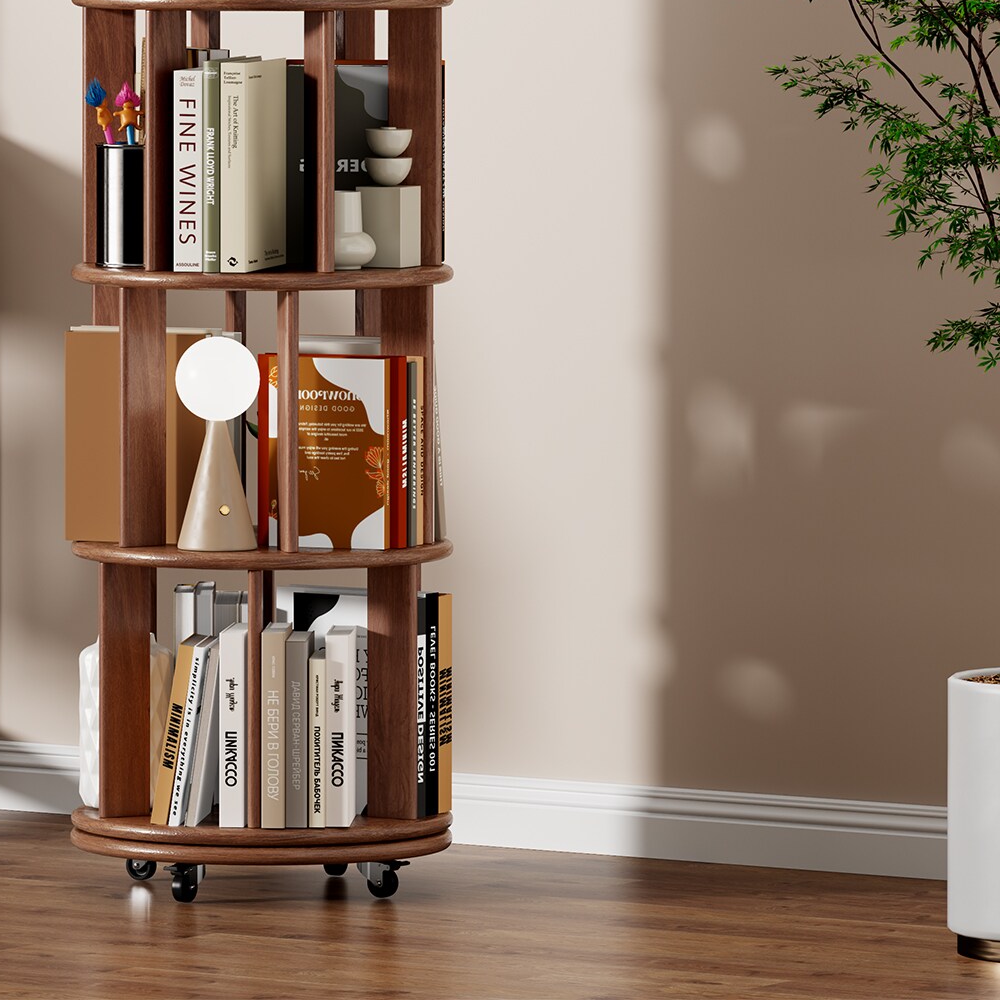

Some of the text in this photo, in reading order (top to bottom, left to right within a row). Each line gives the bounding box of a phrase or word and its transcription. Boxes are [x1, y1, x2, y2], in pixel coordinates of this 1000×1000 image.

[179, 99, 197, 244] FINE WINES
[206, 127, 215, 205] FRANK LLOYD WRIGHT
[188, 657, 200, 704] simplicity
[267, 690, 279, 705] НЕ
[290, 680, 301, 710] ДАВИД
[162, 703, 183, 770] MINIMALISM
[267, 708, 279, 739] БЕРИ
[177, 731, 189, 781] everything
[266, 753, 279, 801] ГОЛОВУ
[331, 732, 344, 787] ПИКАССО
[175, 785, 181, 797] we
